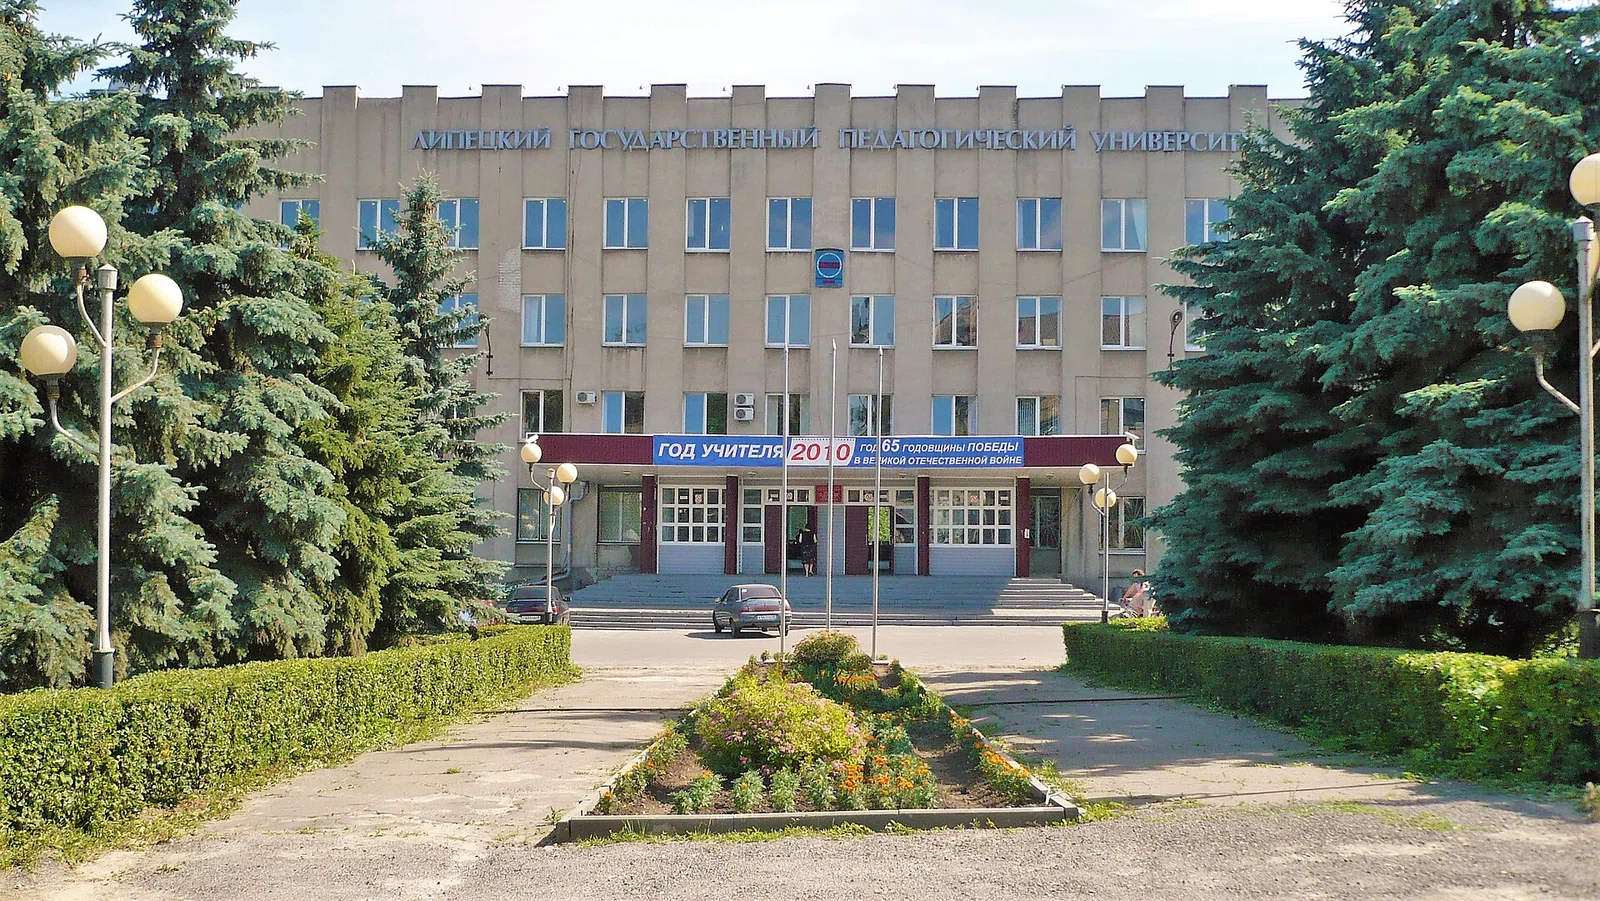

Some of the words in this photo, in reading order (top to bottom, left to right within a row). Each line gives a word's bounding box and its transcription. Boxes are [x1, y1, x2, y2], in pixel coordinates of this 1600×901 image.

[412, 124, 551, 151] ЛИПЕЦКИЙ
[568, 124, 820, 152] ГОСУДАРСТВЕННЫЙ
[838, 124, 1077, 152] ПЕДАГОГИЧЕСКИЙ
[1089, 130, 1264, 153] УНИВЕРСИТ
[658, 443, 696, 460] ГОД
[701, 443, 784, 459] УЧИТЕЛЯ
[791, 443, 851, 461] 2010
[881, 439, 900, 453] 65
[902, 443, 966, 454] ГОДОВЩИНЫ
[967, 441, 1019, 453] ПОБЕДЫ
[853, 456, 861, 465] В
[862, 455, 907, 466] ВЕИКОЙ
[907, 455, 988, 466] ОТЕЧЕСТВЕННОЙ
[989, 454, 1022, 465] ВОЙНЕ
